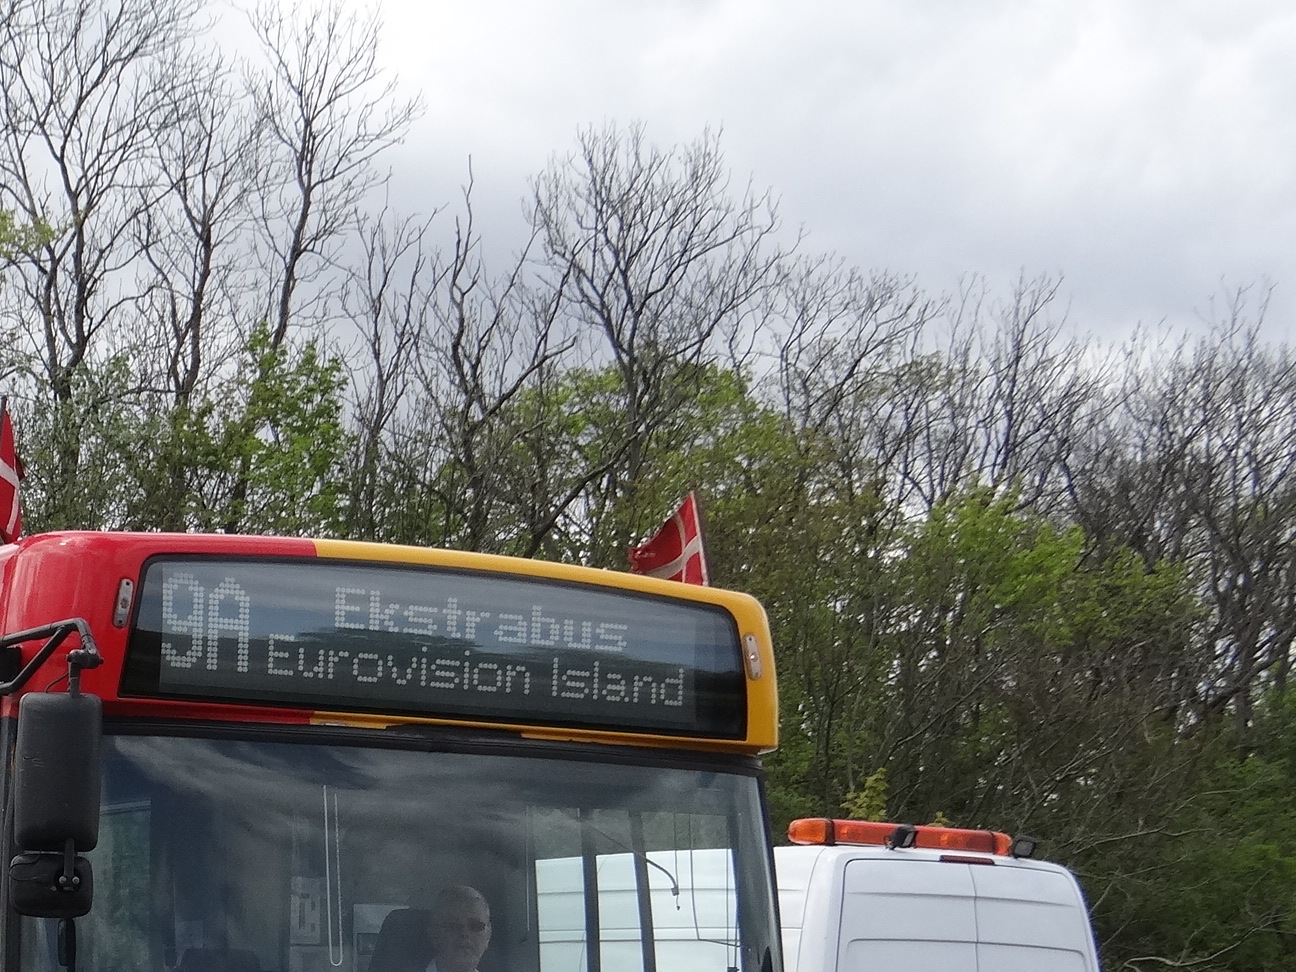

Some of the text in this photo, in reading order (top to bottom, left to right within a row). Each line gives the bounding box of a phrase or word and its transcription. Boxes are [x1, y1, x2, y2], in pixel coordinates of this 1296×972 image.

[160, 572, 251, 674] 9A
[334, 586, 629, 653] Ekstrabus
[267, 632, 685, 708] Eurovision Island
